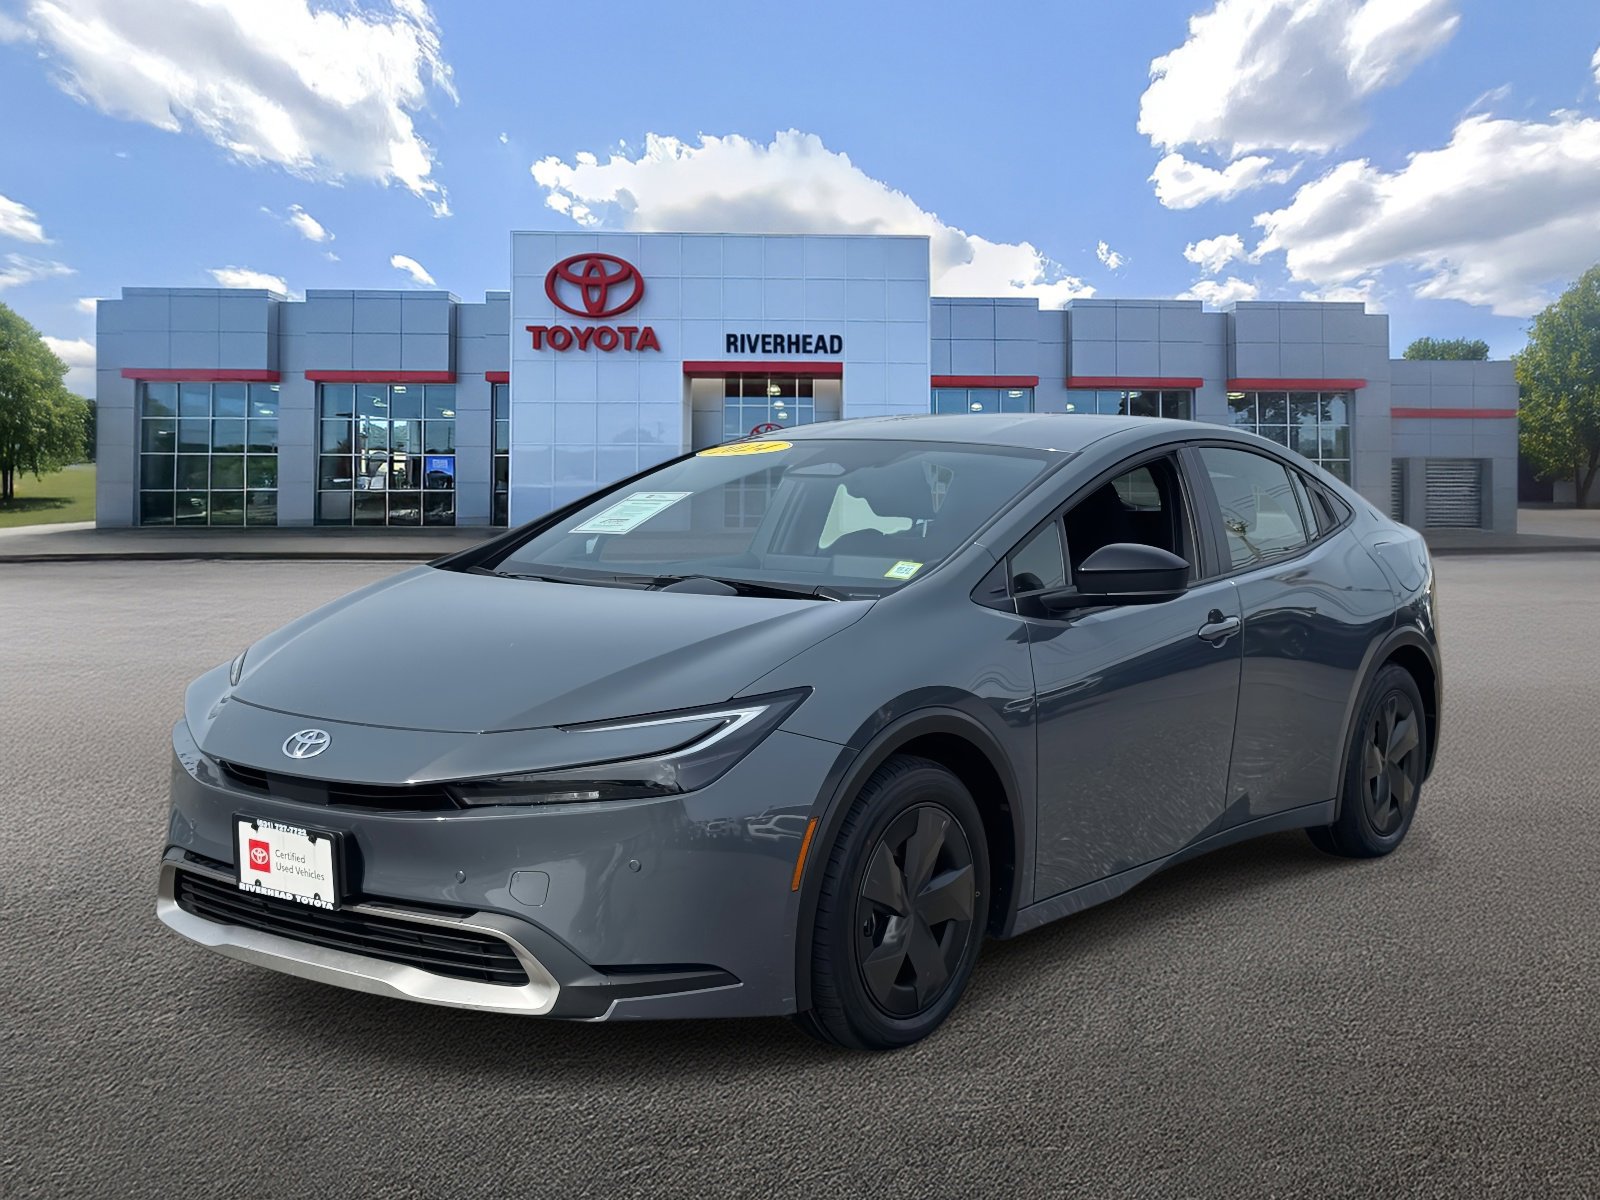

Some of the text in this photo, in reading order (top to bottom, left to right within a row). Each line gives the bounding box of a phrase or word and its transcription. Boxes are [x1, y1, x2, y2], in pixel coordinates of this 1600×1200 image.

[526, 325, 661, 351] TOYOTA
[726, 333, 843, 354] RIVERHEAD
[275, 849, 306, 864] Certified
[276, 862, 325, 881] Used Vehicles
[239, 882, 334, 911] RIVERHEAD TOYOTA
